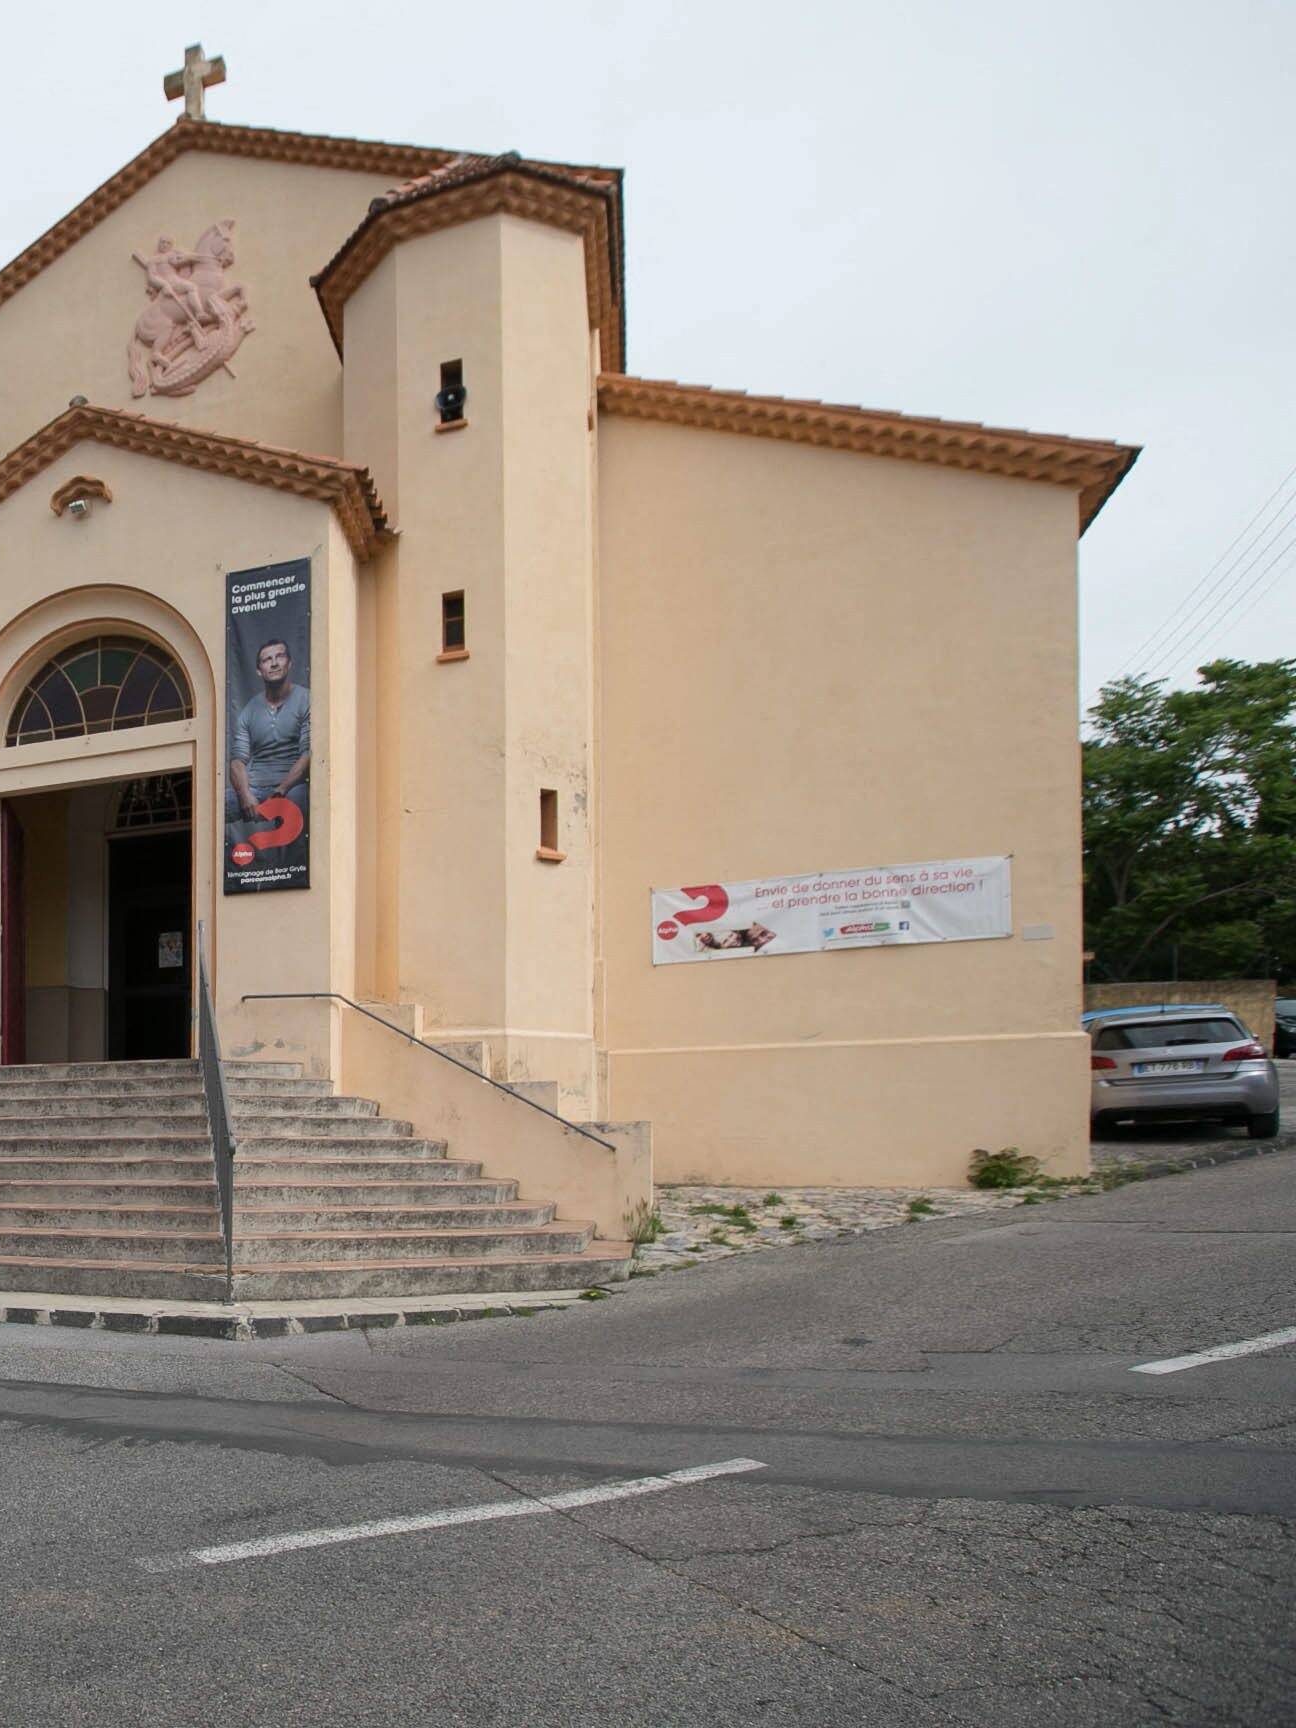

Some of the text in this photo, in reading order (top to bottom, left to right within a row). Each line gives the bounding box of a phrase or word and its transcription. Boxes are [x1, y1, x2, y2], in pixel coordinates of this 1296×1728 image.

[231, 583, 306, 604] la plus grande
[232, 575, 296, 594] Commencer
[231, 600, 277, 614] aventure
[755, 885, 788, 898] Envie
[792, 882, 809, 894] de
[813, 878, 860, 892] donner
[864, 874, 882, 886] du
[886, 873, 916, 884] sens
[920, 868, 929, 882] à
[932, 870, 949, 880] sa
[788, 893, 841, 908] prendre
[844, 891, 858, 902] la
[862, 886, 907, 900] bonne
[911, 880, 975, 896] direction
